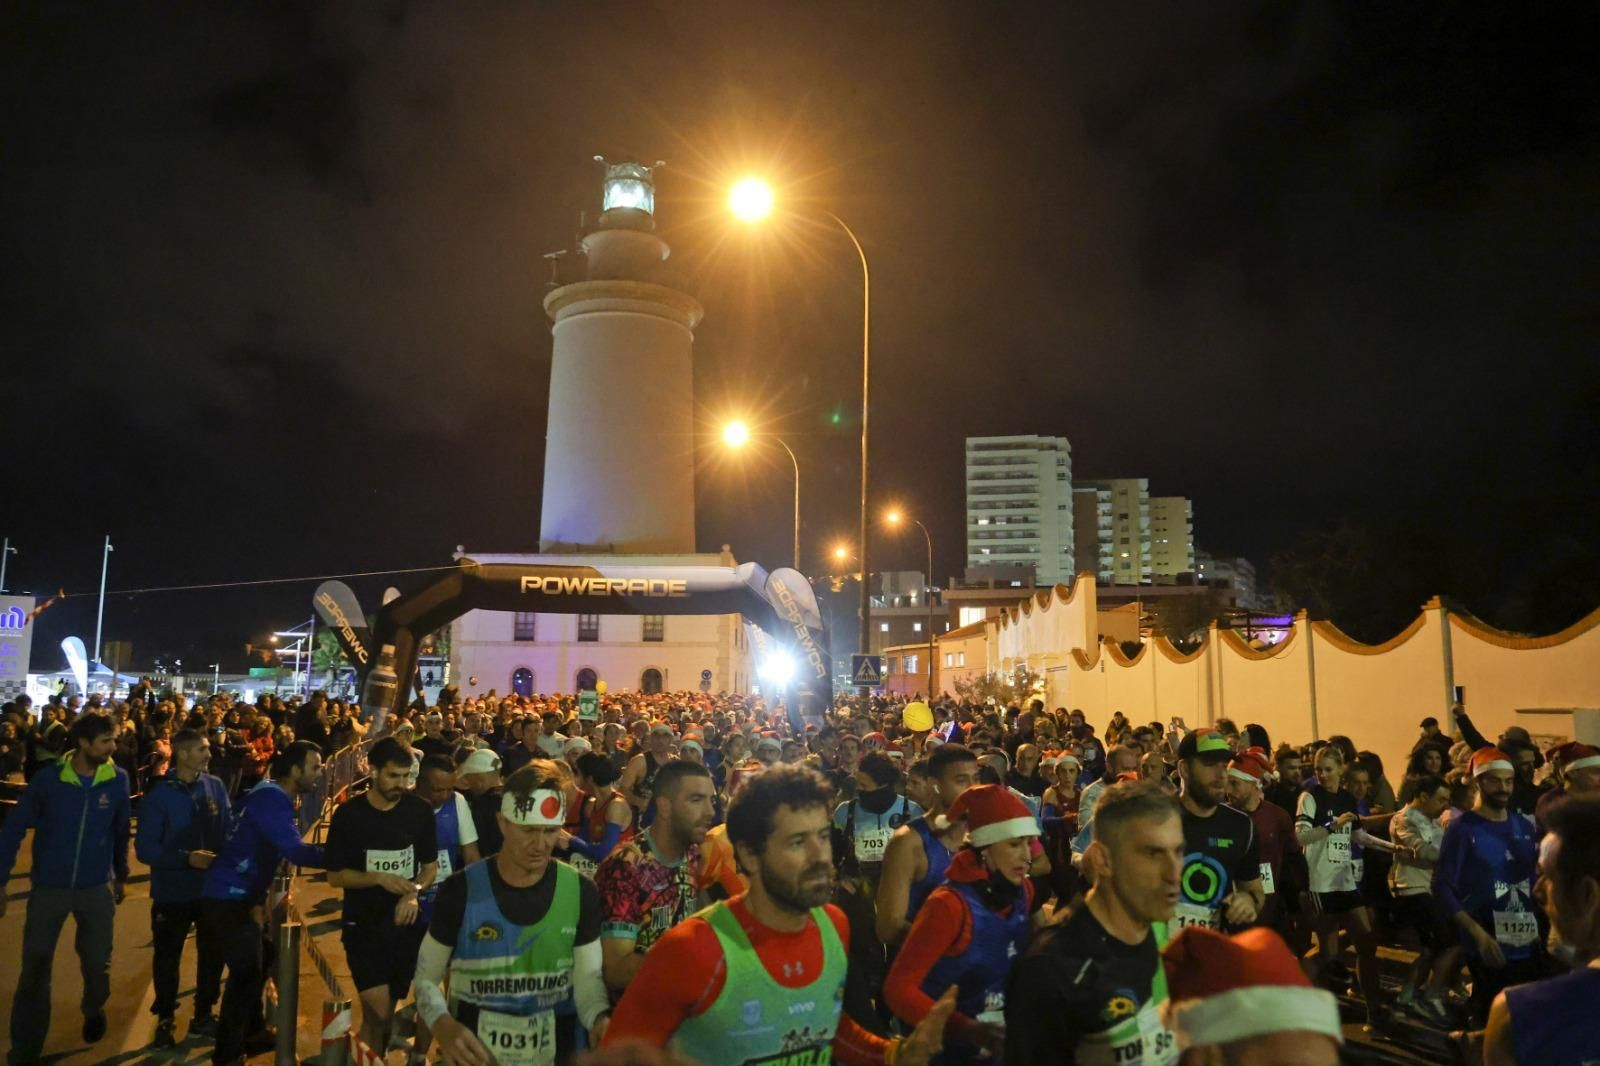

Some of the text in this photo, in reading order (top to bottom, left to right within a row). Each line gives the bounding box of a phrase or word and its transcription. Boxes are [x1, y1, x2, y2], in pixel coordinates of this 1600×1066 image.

[521, 576, 688, 598] POWERADE
[863, 840, 884, 849] 703
[374, 859, 406, 871] 1061
[1502, 922, 1530, 934] 1127
[488, 1030, 538, 1049] 1031
